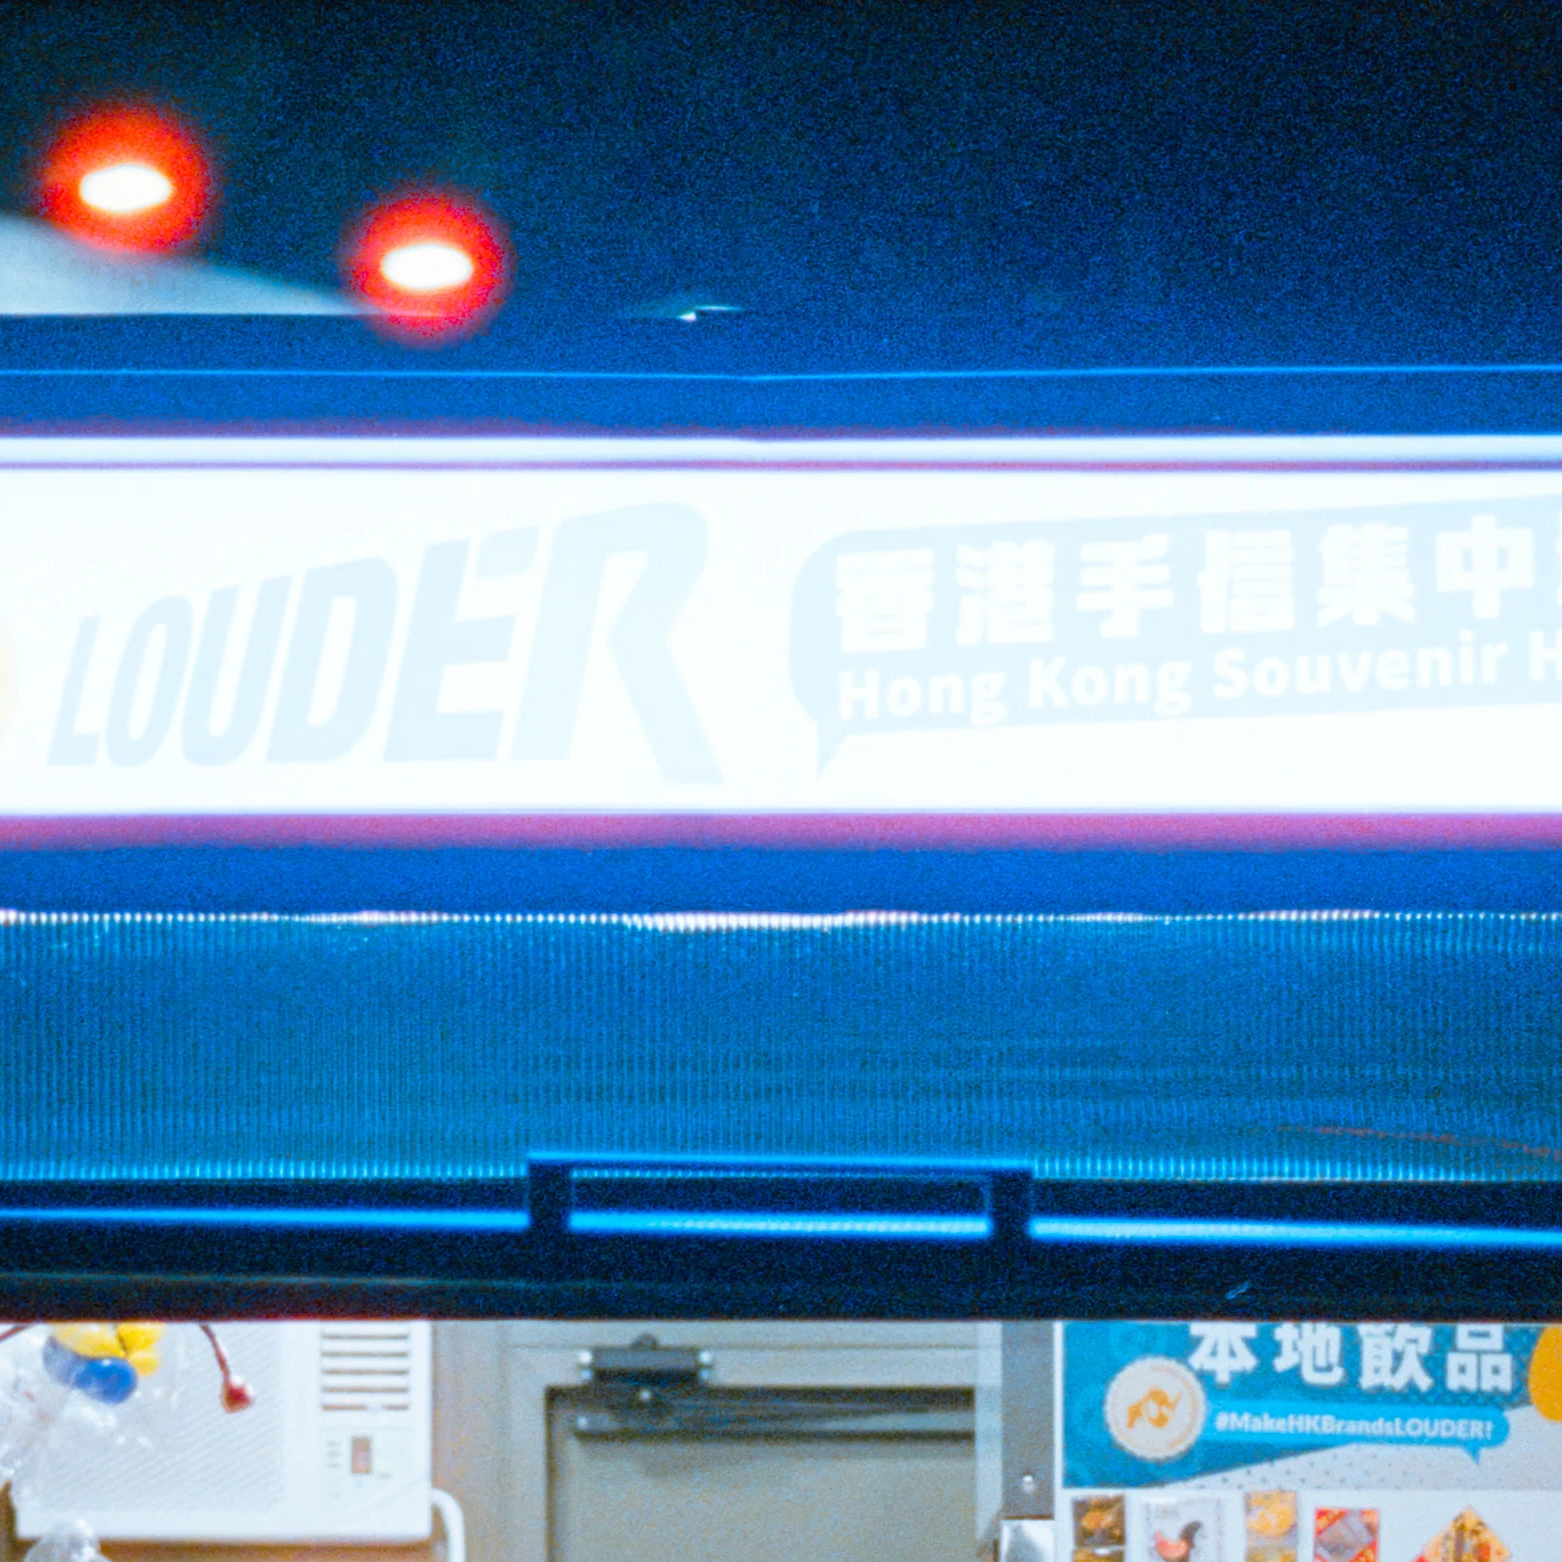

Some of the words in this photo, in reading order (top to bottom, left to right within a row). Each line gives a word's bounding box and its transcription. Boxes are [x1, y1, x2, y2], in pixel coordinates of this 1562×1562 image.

[46, 500, 726, 784] LOUDER
[838, 667, 1008, 727] Hong
[1028, 655, 1193, 716] Kong
[1212, 630, 1509, 701] Souvenir
[1188, 1322, 1514, 1394] 本地飲品
[1215, 1410, 1494, 1441] #MakeHKBrandsLOUDER!
